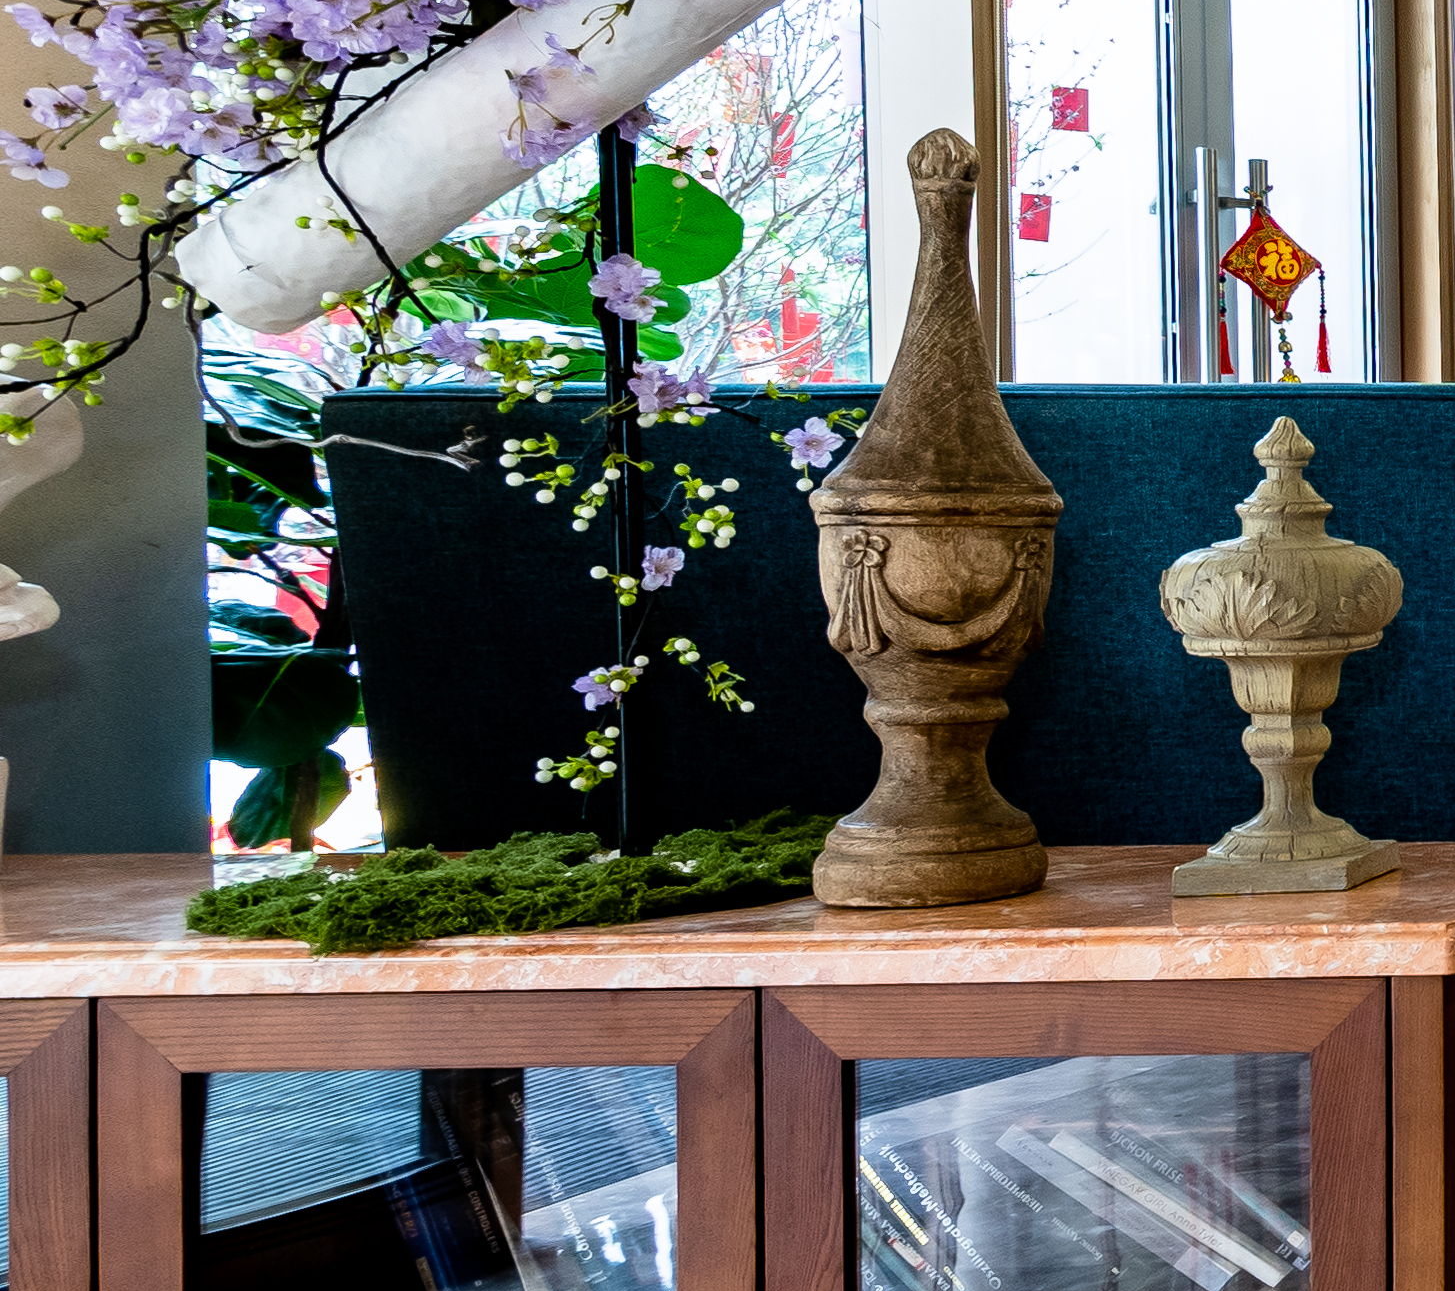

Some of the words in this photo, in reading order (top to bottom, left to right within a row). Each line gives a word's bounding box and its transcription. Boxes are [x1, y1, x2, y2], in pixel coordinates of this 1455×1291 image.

[1259, 240, 1299, 280] 福
[424, 1084, 462, 1161] PROGRAMMABLE
[467, 1189, 501, 1253] CONTROLLERS
[1110, 1130, 1153, 1164] BICHON
[1153, 1158, 1184, 1184] FRISE
[559, 1203, 594, 1263] Corrosion
[879, 1143, 1002, 1290] Oszillografen-Meßtechnik
[1098, 1161, 1145, 1196] VINEGAR
[1143, 1191, 1168, 1212] GIRL
[1169, 1209, 1197, 1232] Anne
[1196, 1227, 1223, 1250] Tyler
[1079, 1238, 1104, 1261] Борис
